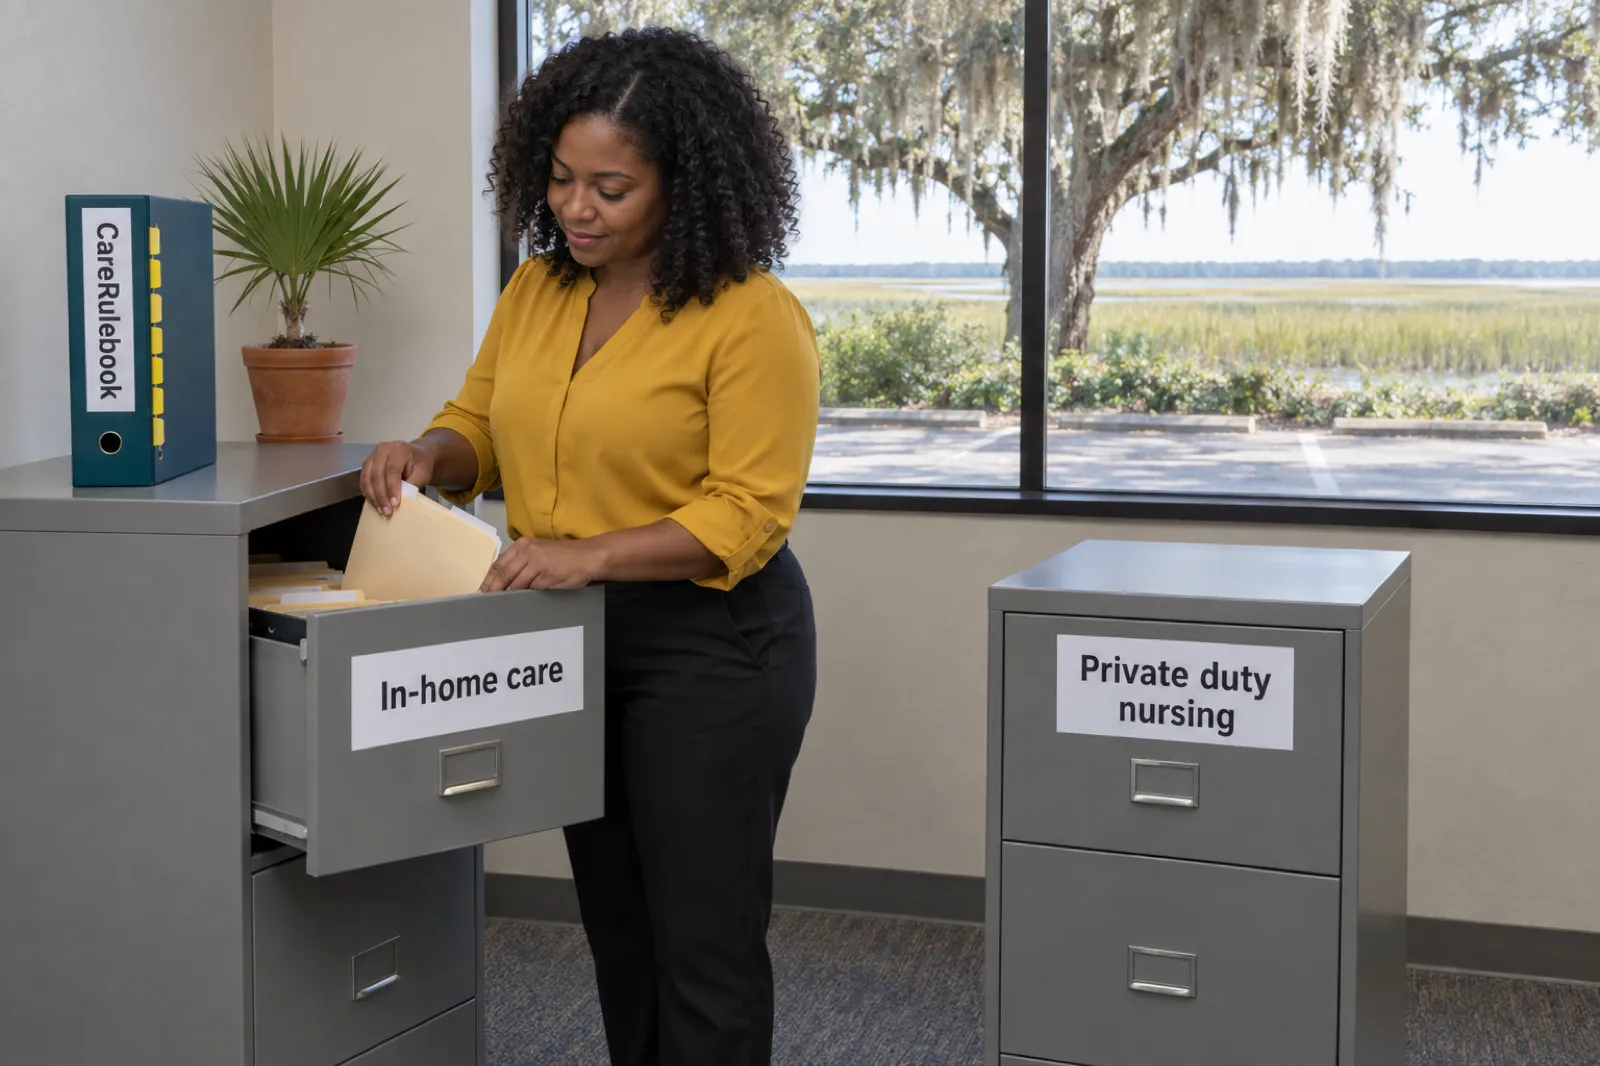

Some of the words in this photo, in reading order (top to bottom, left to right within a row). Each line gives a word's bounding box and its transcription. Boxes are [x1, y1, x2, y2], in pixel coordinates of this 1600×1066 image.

[96, 222, 122, 400] CareRulebook
[381, 671, 498, 711] In-home
[506, 661, 564, 690] care
[1081, 654, 1189, 688] Private
[1200, 661, 1272, 701] duty
[1119, 698, 1235, 737] nursing
